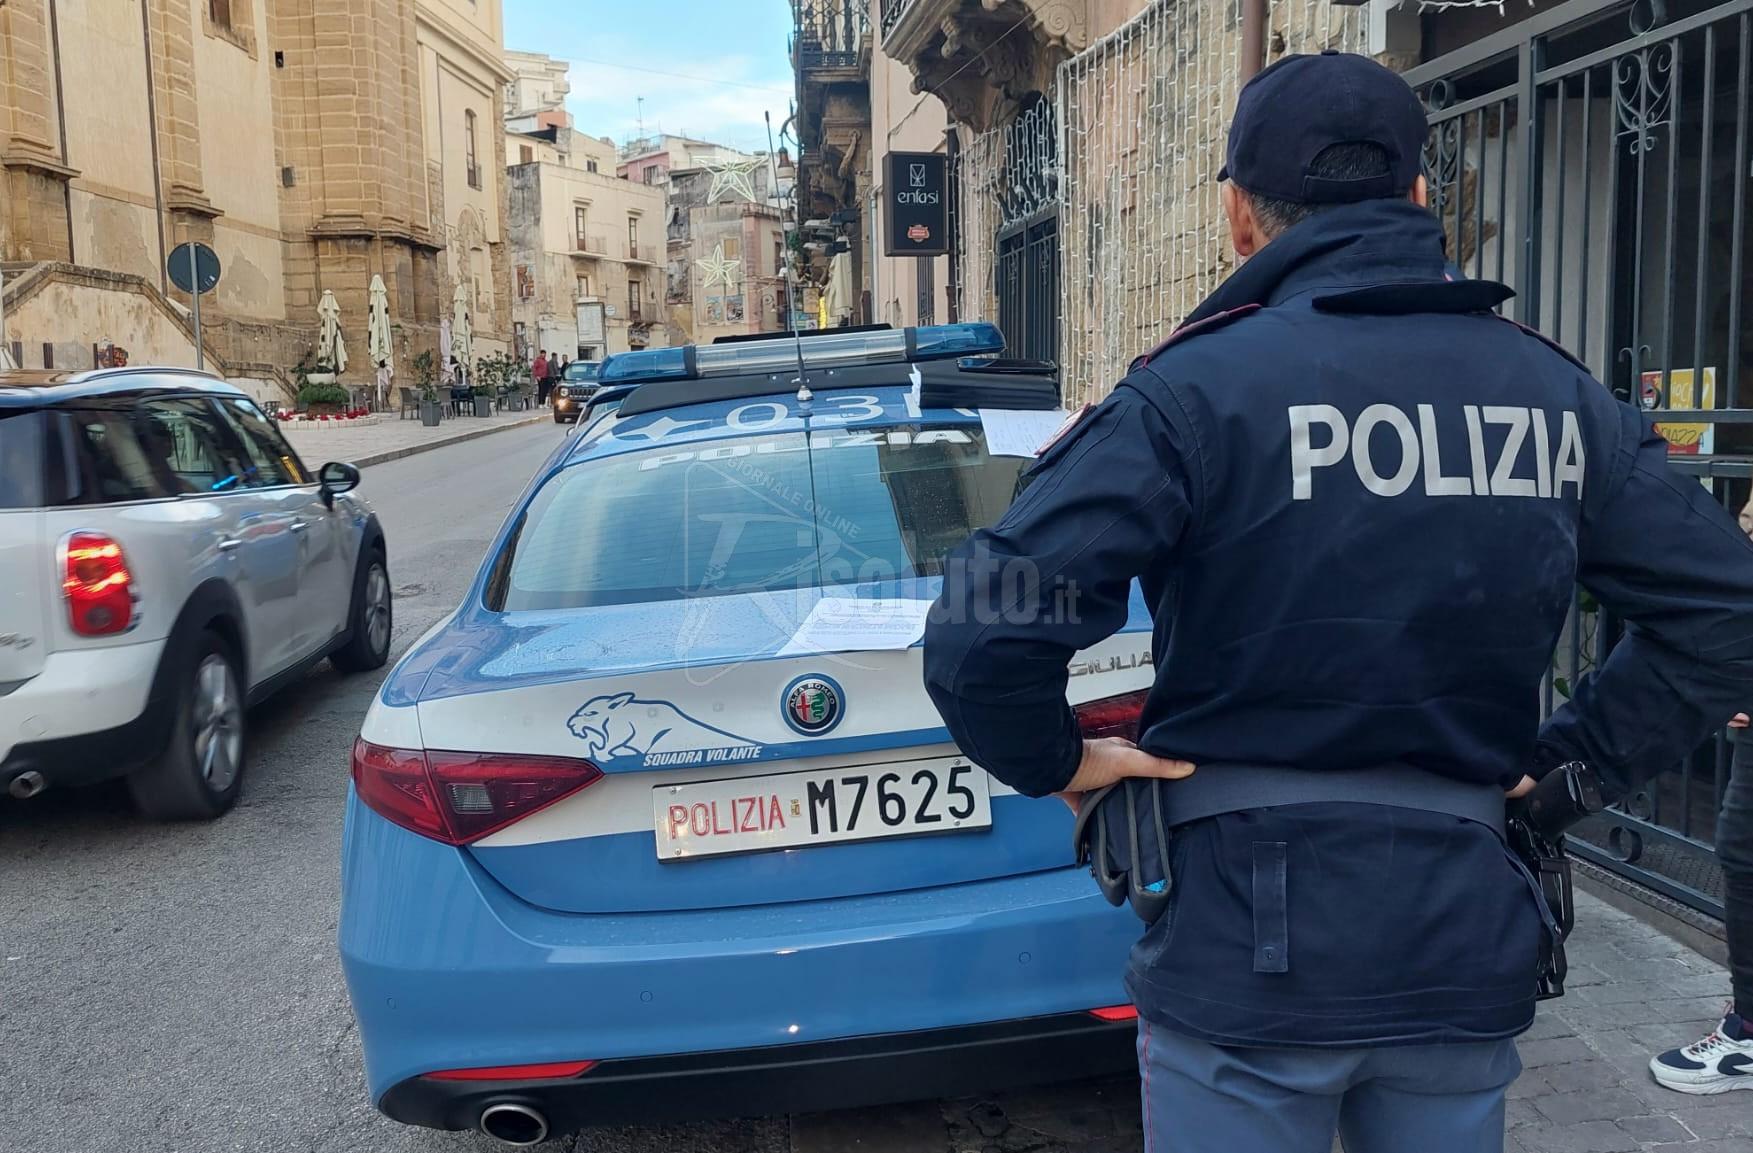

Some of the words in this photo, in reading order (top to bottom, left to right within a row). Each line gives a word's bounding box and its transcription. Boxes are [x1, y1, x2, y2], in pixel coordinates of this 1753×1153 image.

[897, 189, 939, 204] enfasi
[639, 429, 972, 471] POLIZIA
[1288, 403, 1585, 500] POLIZIA
[1069, 651, 1153, 677] GIULIA
[790, 687, 805, 708] ALFA
[807, 683, 835, 705] ROMEO
[643, 750, 702, 767] SQUADRA
[706, 745, 762, 762] VOLANTE
[668, 794, 786, 841] POLIZIA
[806, 765, 976, 835] M7625
